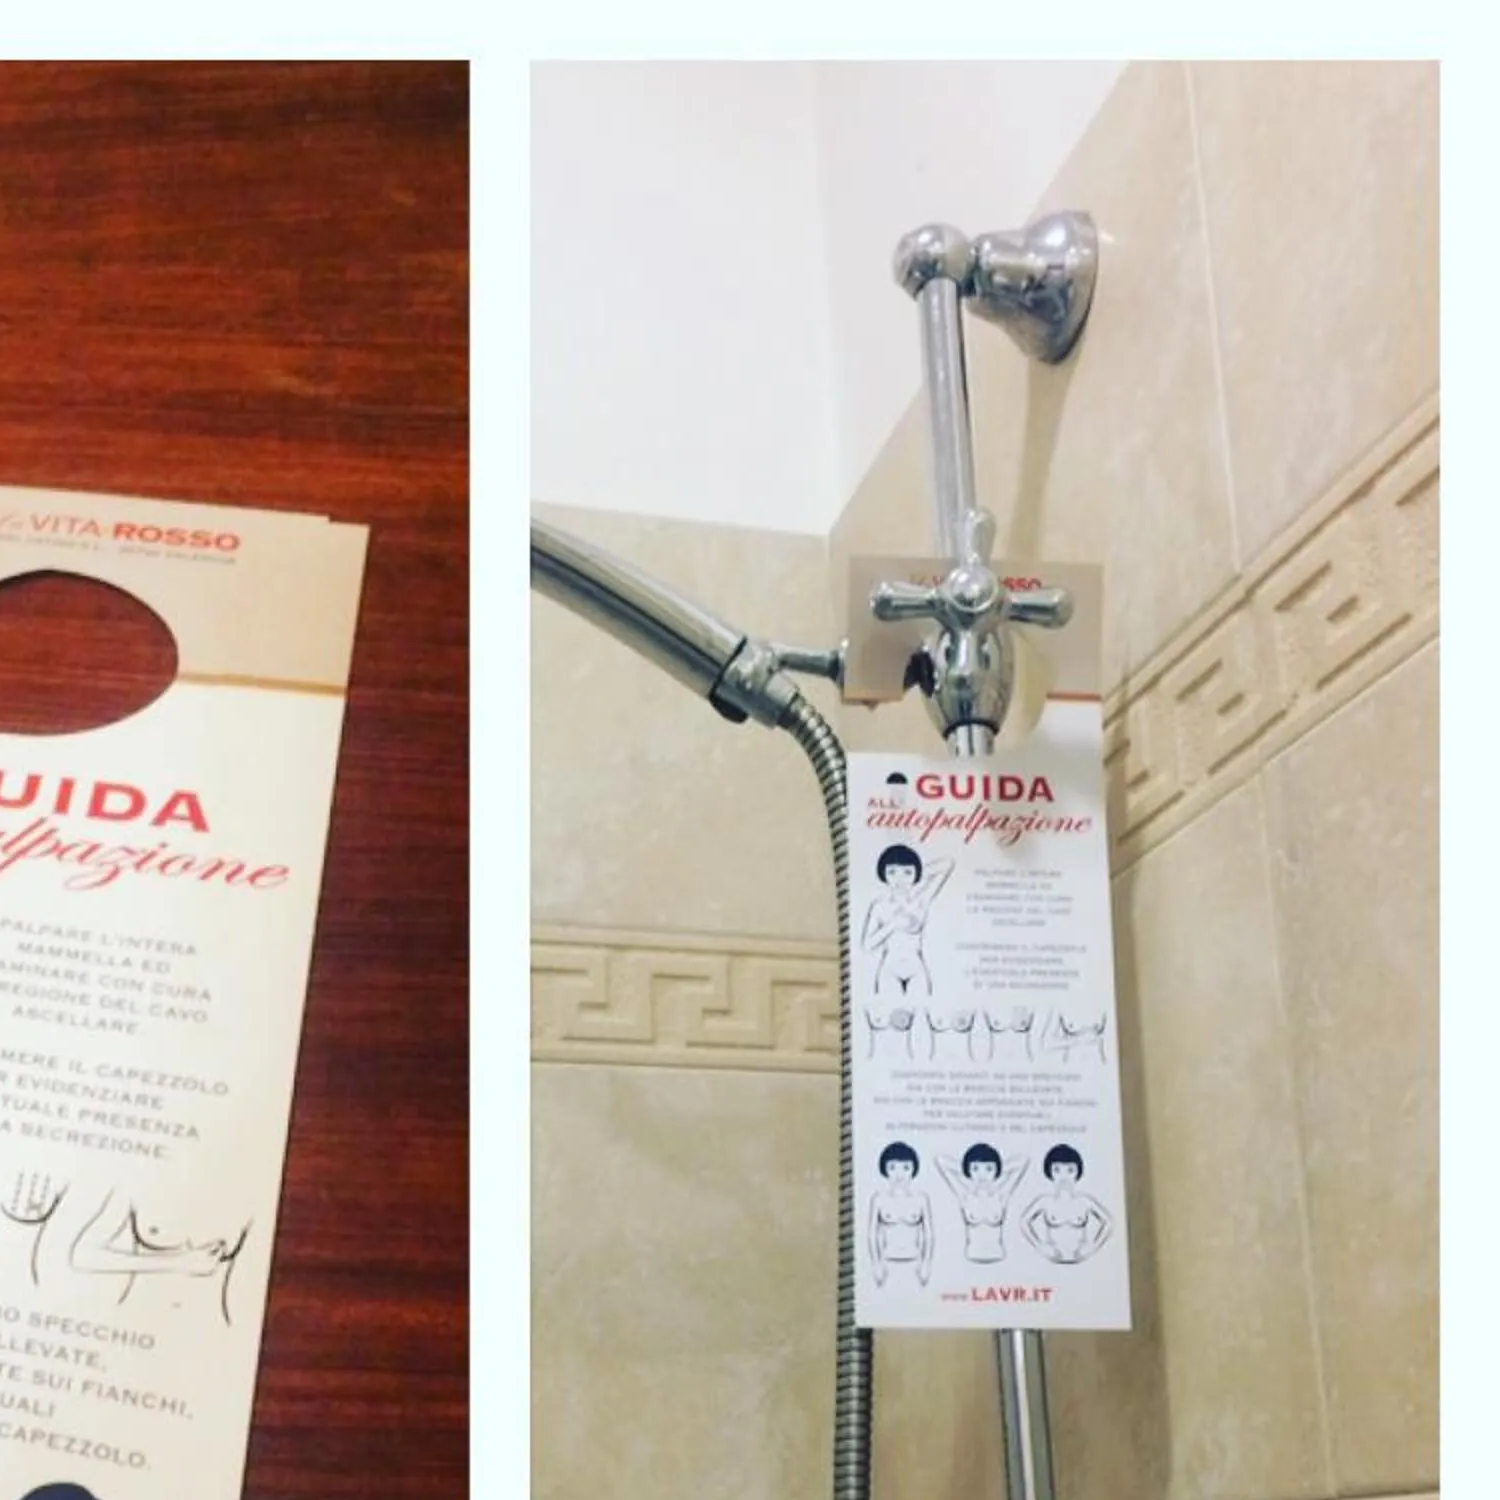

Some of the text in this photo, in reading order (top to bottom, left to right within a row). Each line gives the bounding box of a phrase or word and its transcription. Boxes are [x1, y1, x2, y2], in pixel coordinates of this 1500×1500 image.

[29, 513, 102, 538] VITA
[112, 521, 241, 552] ROSSO
[916, 774, 1054, 803] GUIDA
[867, 803, 1092, 845] autopalpazione
[0, 917, 197, 956] PALPARE L'INTERA
[17, 941, 172, 975] MAMMELLA ED
[97, 974, 145, 993] CON
[151, 979, 212, 1003] CURA
[99, 995, 141, 1015] DEL
[148, 1002, 209, 1024] CAVO
[16, 1074, 165, 1111] EVIDENZIARE
[68, 1059, 87, 1075] IL
[94, 1063, 230, 1096] CAPEZZOLO
[77, 1108, 201, 1141] PRESENZA
[28, 1312, 156, 1350] SPECCHIO
[32, 1370, 72, 1391] SUI
